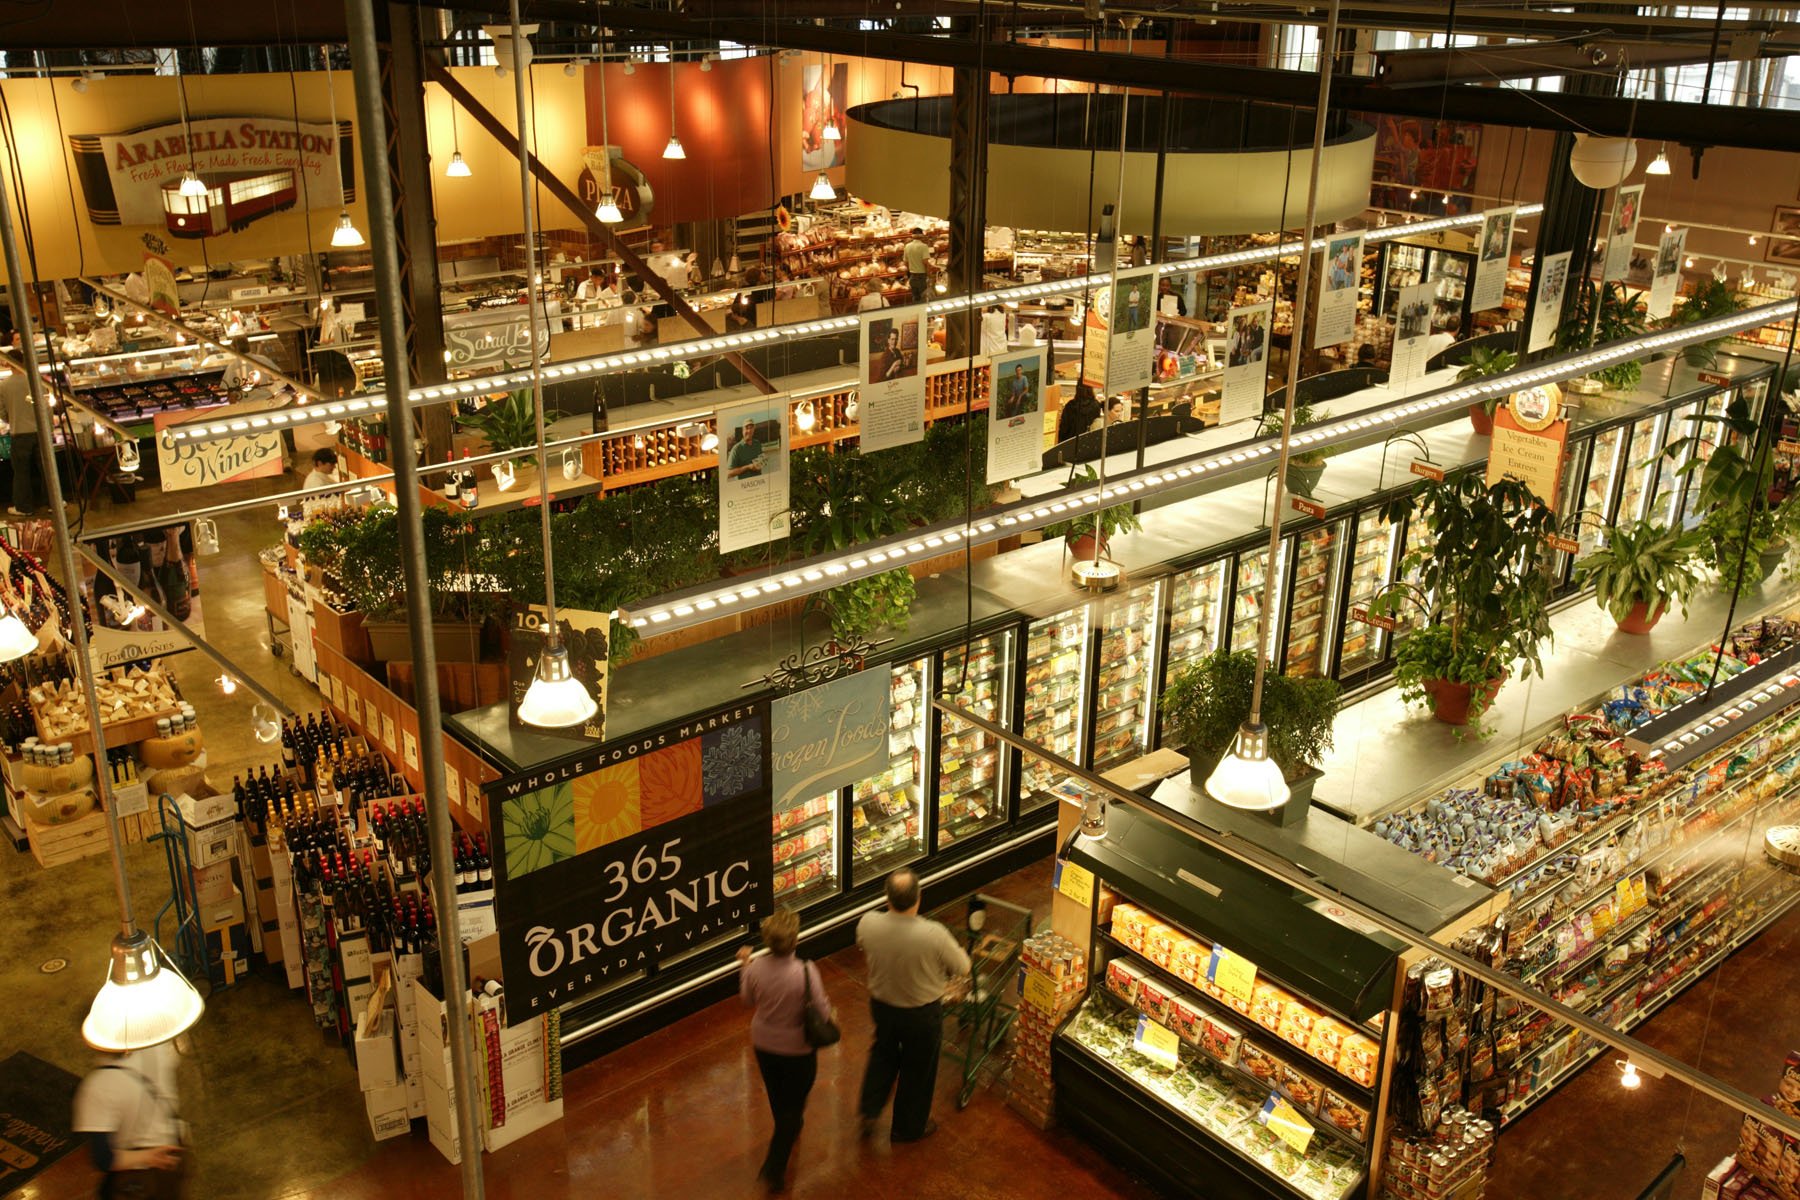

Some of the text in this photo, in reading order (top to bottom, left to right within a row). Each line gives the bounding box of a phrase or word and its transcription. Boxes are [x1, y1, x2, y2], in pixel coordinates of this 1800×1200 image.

[131, 168, 164, 183] Fresh
[209, 154, 239, 168] Made
[242, 153, 273, 166] Fresh
[585, 179, 633, 211] PIZA
[1502, 443, 1545, 461] Ice Cream
[1506, 430, 1549, 448] Vegetables
[184, 440, 278, 484] Wines
[1508, 458, 1538, 473] Entrees
[1298, 502, 1315, 515] Pasta
[516, 612, 540, 629] 10
[507, 705, 755, 795] WHOLE FOODS MARKET
[771, 724, 828, 773] rozen
[603, 837, 682, 903] 365
[524, 860, 750, 977] ORGANIC
[531, 904, 757, 1008] EVERYDAY VALUE
